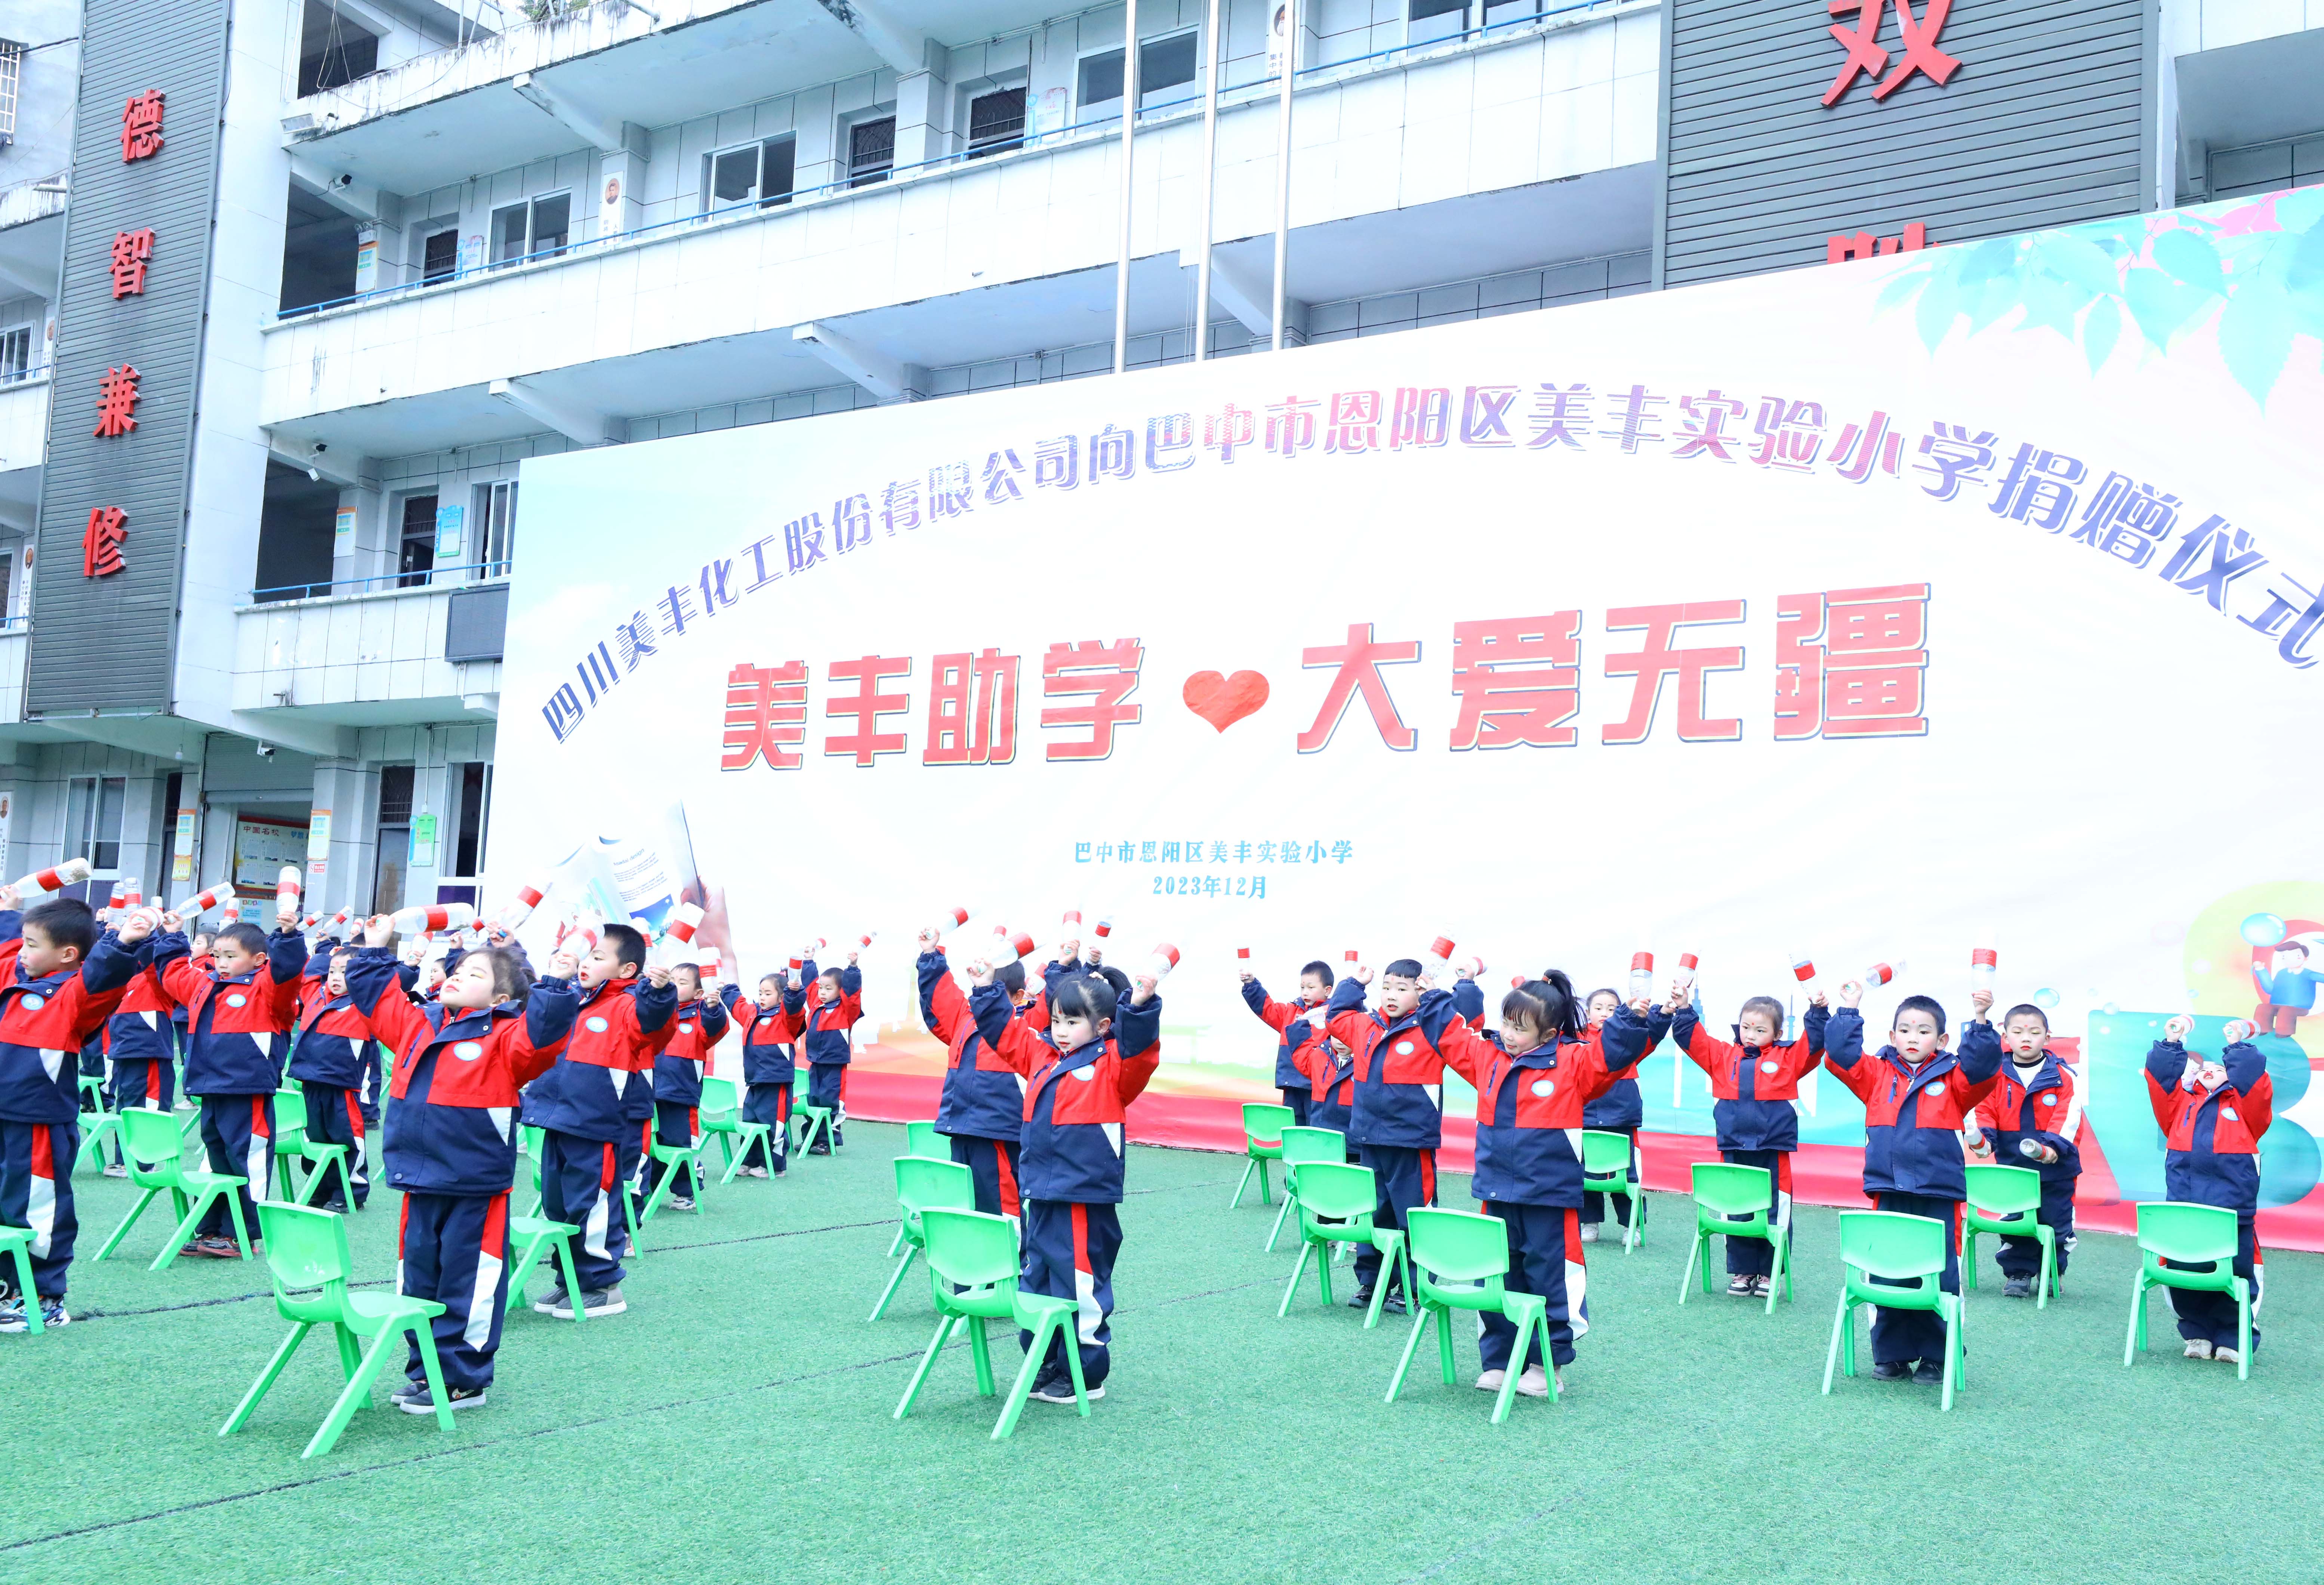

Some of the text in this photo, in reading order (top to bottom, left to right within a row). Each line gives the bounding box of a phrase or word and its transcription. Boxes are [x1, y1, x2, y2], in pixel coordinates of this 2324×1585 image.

[82, 89, 166, 577] 德智兼修
[542, 382, 2324, 744] 四川美丰化工股份有限公司向巴中市恩阳区美丰实验小学捐赠仪式
[721, 582, 1932, 771] 美丰助学 大爱无疆
[1075, 840, 1353, 864] 巴中市恩阳区美丰实验小学
[1153, 875, 1267, 899] 2023年12月
